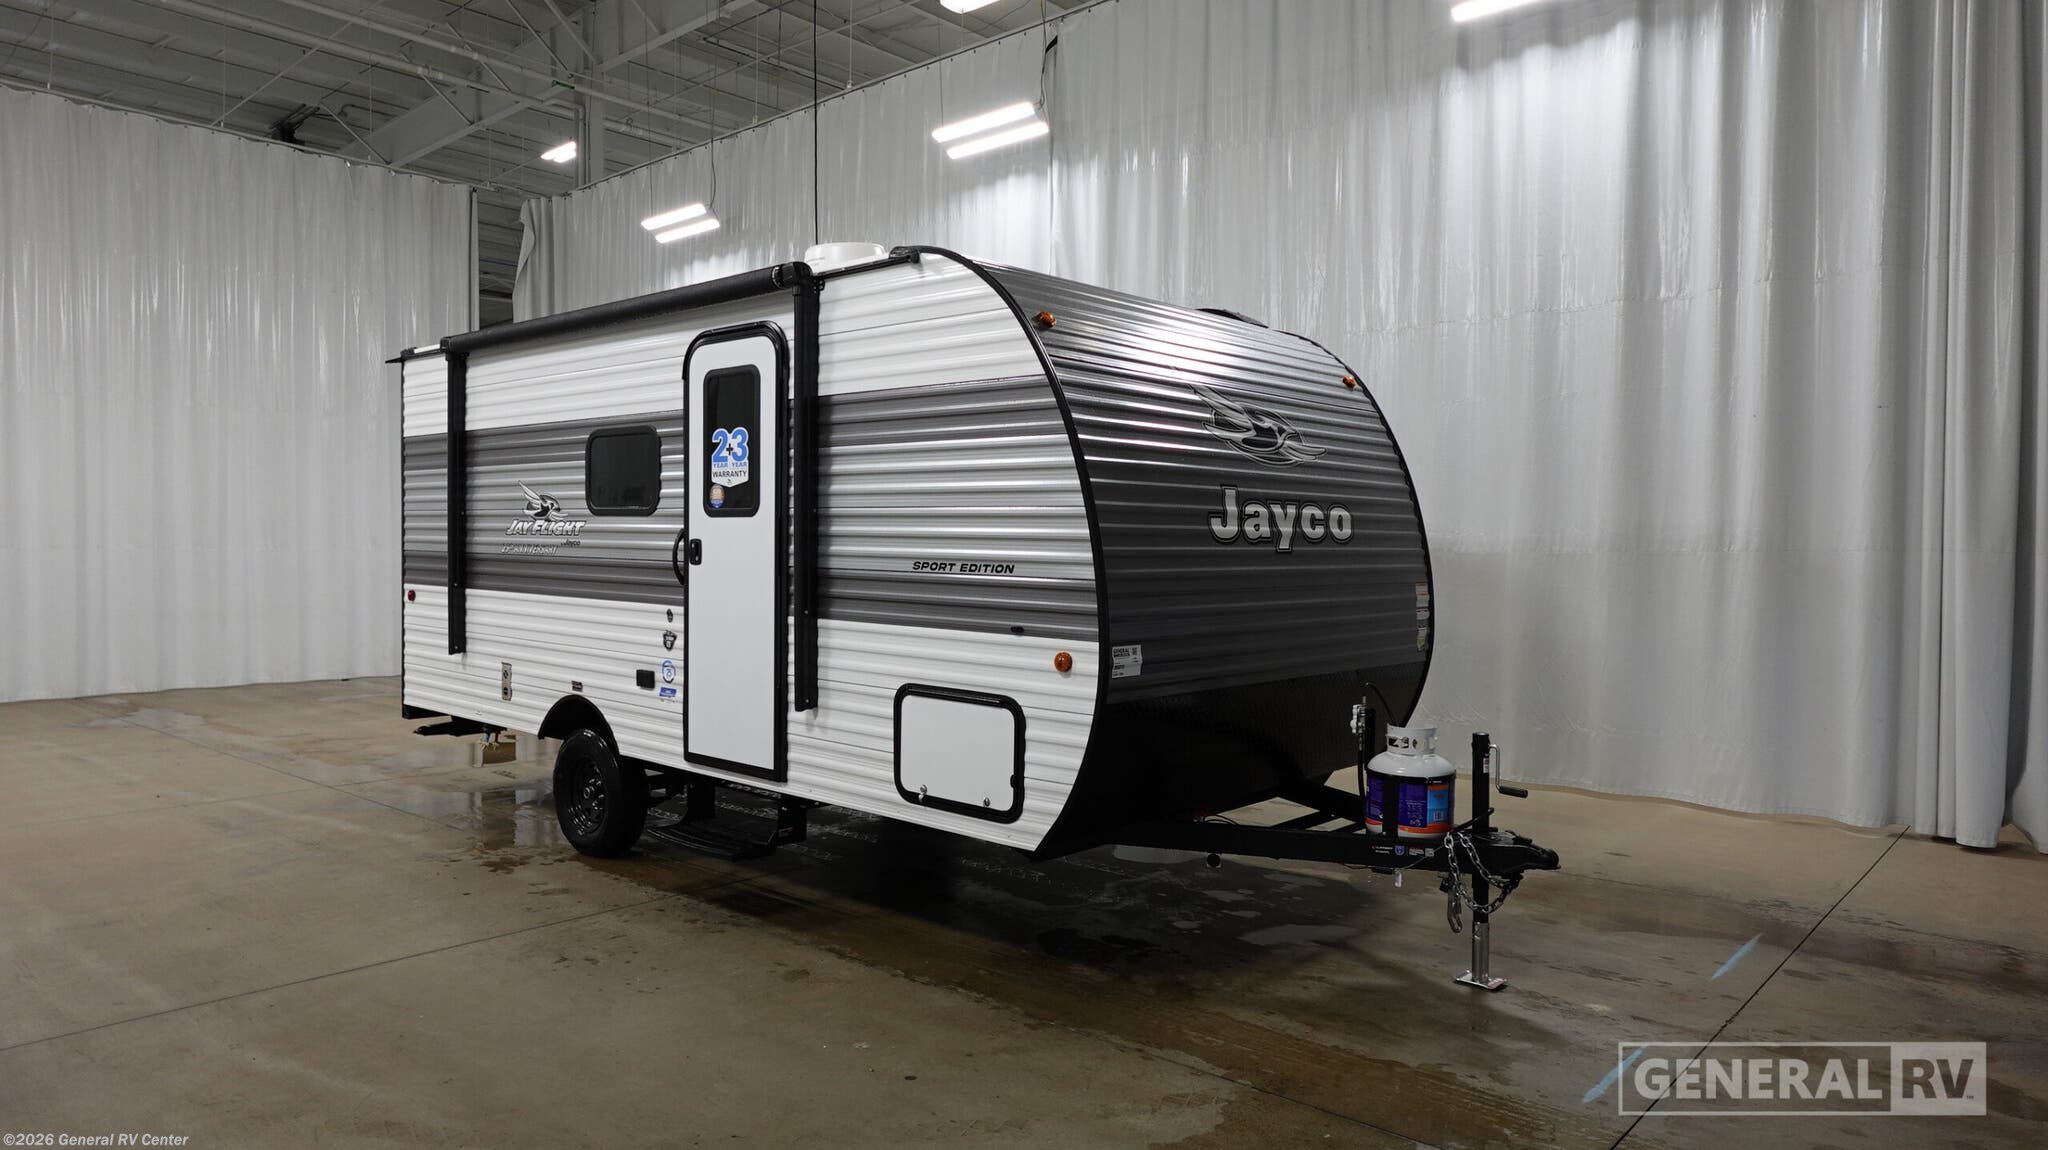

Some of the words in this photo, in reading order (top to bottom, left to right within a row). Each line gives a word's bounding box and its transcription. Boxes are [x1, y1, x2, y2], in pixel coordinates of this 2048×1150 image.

[713, 470, 747, 478] WARRANTY
[1209, 485, 1353, 552] Jayco
[505, 519, 531, 535] JAY
[531, 519, 586, 536] FLIGHT
[912, 561, 956, 572] SPORT
[960, 563, 1015, 574] EDITION
